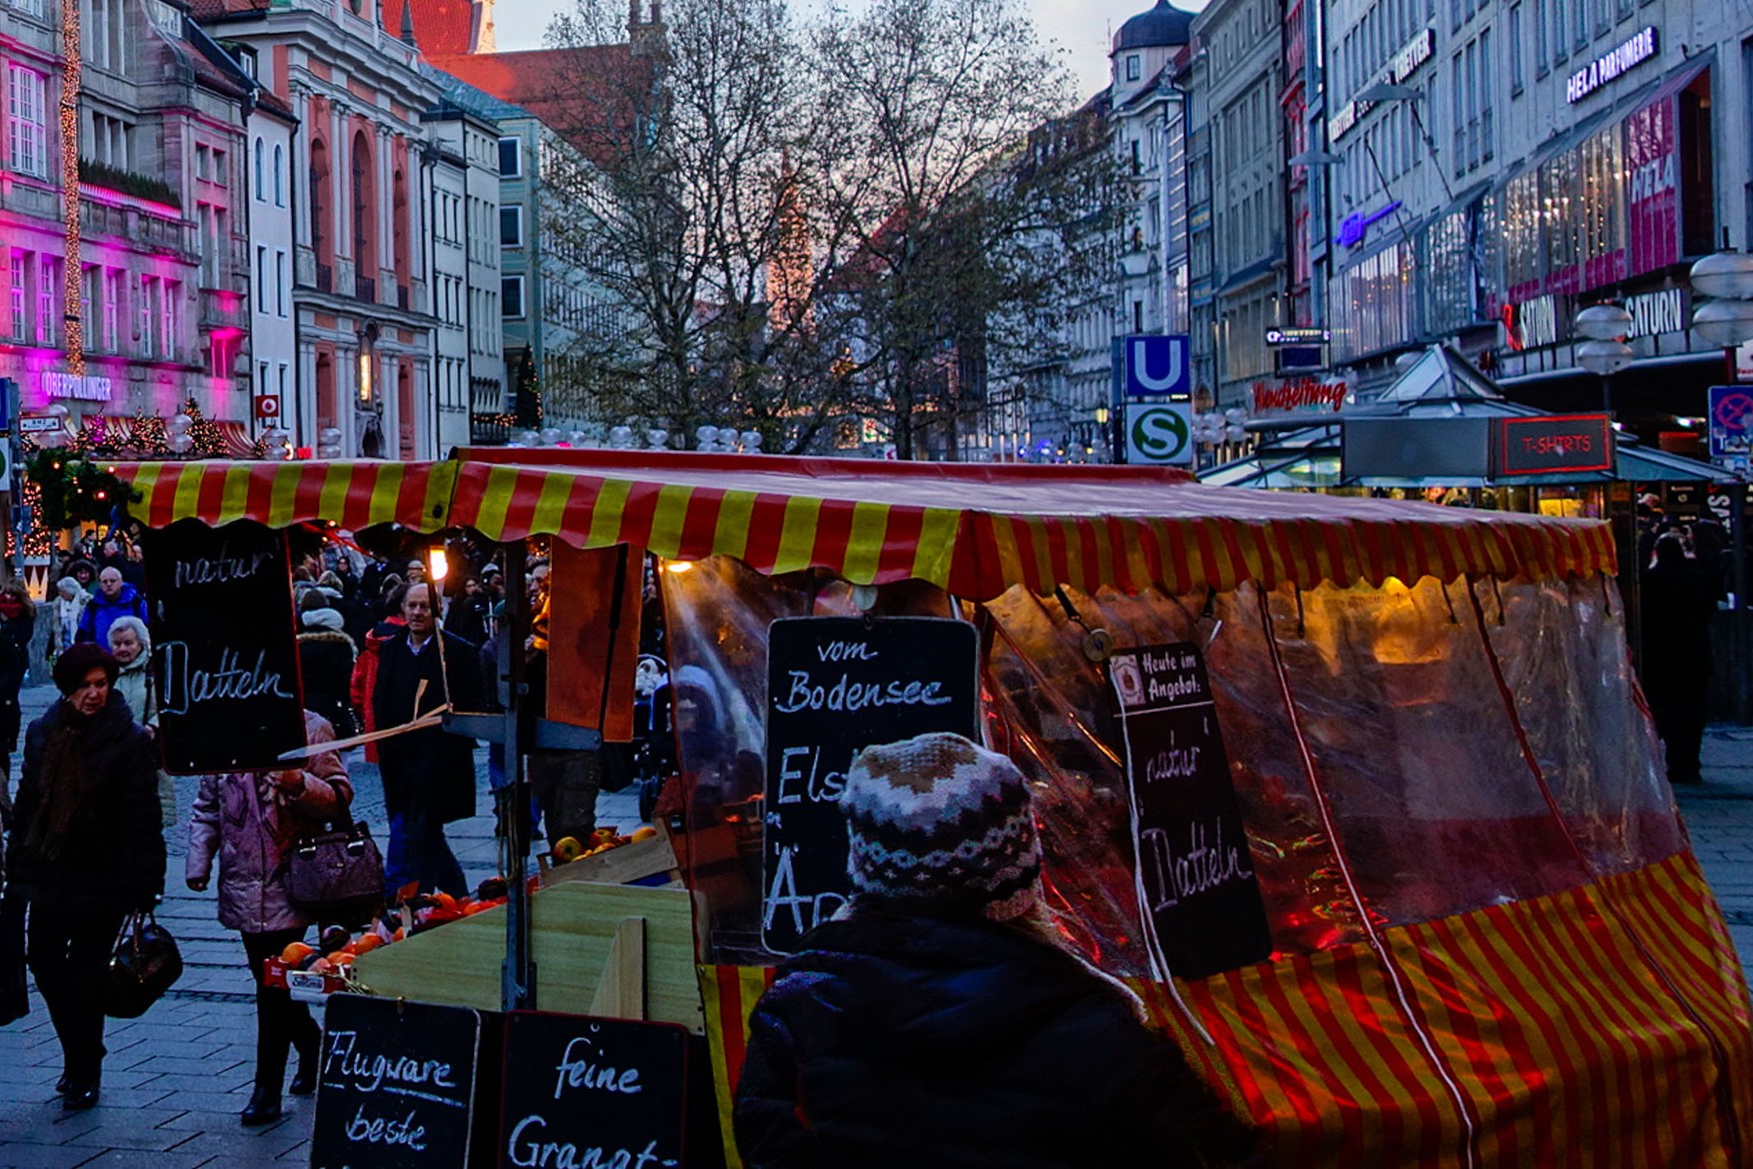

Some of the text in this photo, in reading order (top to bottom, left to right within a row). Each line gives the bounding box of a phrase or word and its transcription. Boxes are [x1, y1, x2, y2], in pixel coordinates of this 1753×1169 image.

[1567, 61, 1598, 103] HELA
[1631, 153, 1674, 205] HELA
[1520, 293, 1556, 350] SATURN
[1626, 289, 1683, 339] SATURN
[45, 371, 113, 402] OBERPOLLINGER
[1134, 340, 1182, 391] U
[1141, 413, 1179, 456] S
[1521, 434, 1592, 454] T-SHIRTS
[817, 640, 878, 662] vom
[1143, 649, 1197, 675] Heute im
[155, 640, 295, 716] Datteln
[775, 669, 953, 713] Bodensee
[1149, 673, 1202, 702] Angebot:
[778, 746, 858, 804] Els
[1141, 815, 1252, 912] Datteln
[324, 1030, 457, 1093] Flugware
[554, 1037, 643, 1100] feine
[345, 1102, 428, 1152] beste
